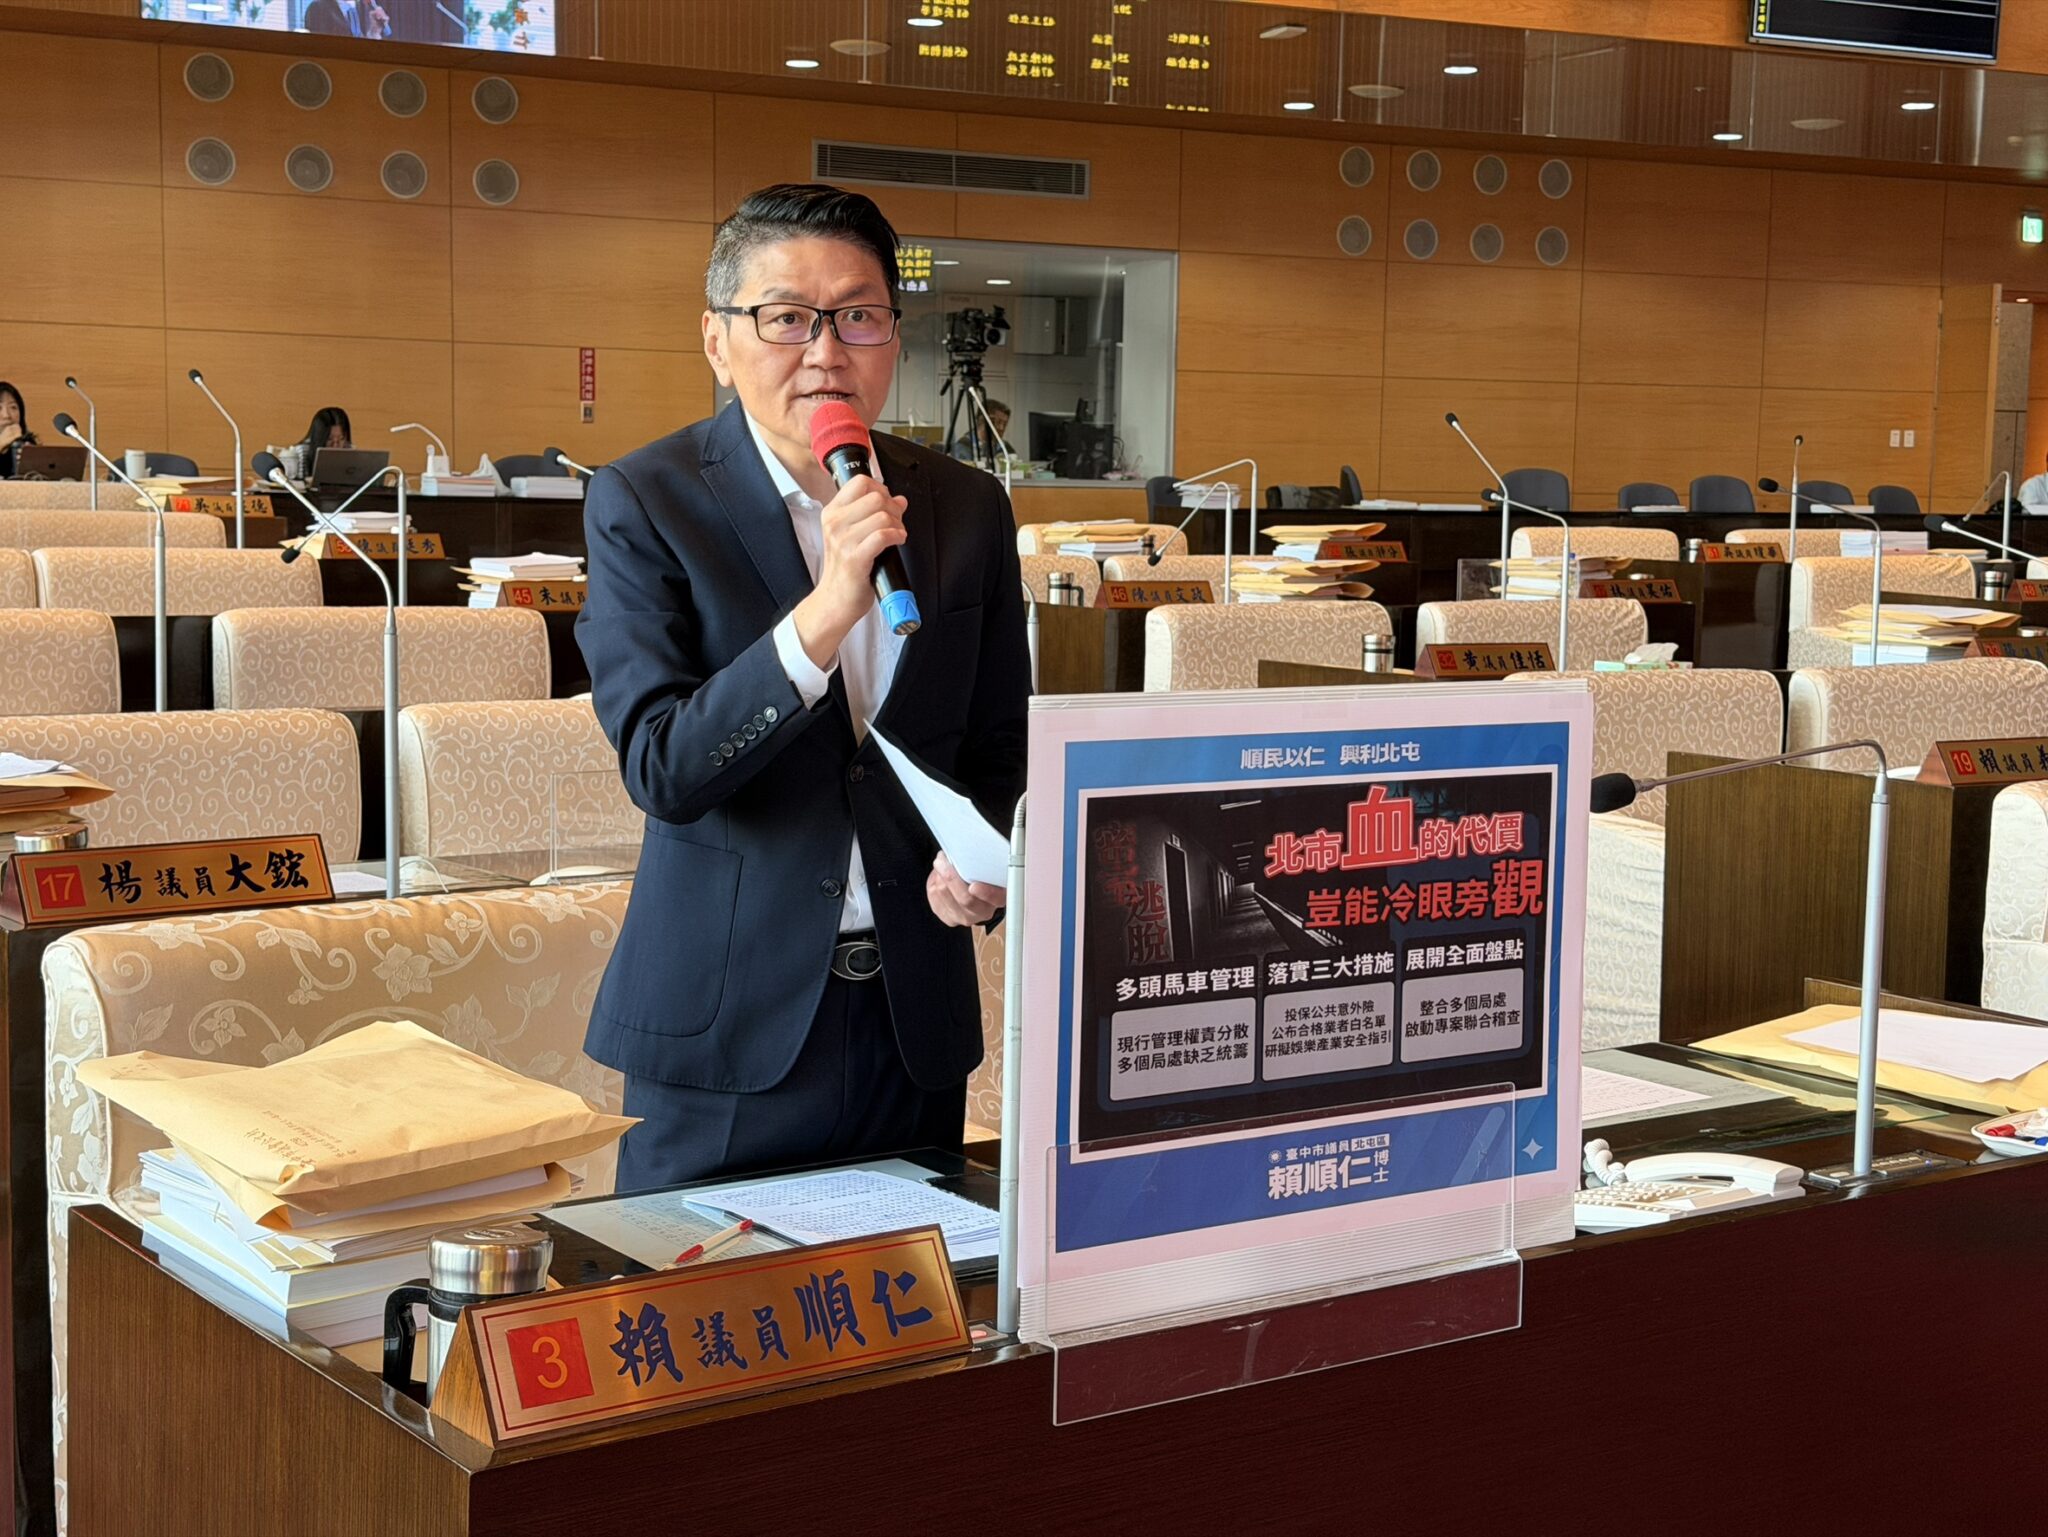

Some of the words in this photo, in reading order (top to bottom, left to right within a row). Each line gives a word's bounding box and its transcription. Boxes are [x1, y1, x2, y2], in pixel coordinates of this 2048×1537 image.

[514, 589, 532, 604] 45
[1112, 587, 1127, 600] 46
[1438, 651, 1456, 668] 32
[1241, 745, 1326, 770] 順民以仁
[1340, 741, 1421, 765] 興利北屯
[1953, 751, 1973, 773] 19
[41, 872, 76, 902] 17
[97, 847, 310, 905] 楊議員大鋐
[1304, 859, 1544, 928] 豈能冷眼旁觀
[1267, 950, 1395, 988] 落實三大措施
[1405, 938, 1525, 972] 展開全面盤點
[1116, 964, 1256, 1002] 多頭馬車管理
[1284, 999, 1375, 1023] 投保公共意外險
[1419, 991, 1508, 1017] 整合多個局處
[1116, 1022, 1250, 1053] 現行管理權責分散
[1271, 1014, 1387, 1040] 公布合格業者白名單
[1264, 1029, 1392, 1058] 研擬娛樂產業安全指引
[1117, 1042, 1249, 1075] 多個局處缺乏統籌
[1353, 1135, 1387, 1150] 北屯區
[1267, 1154, 1373, 1200] 賴順仁
[1372, 1149, 1390, 1184] 博士
[531, 1335, 568, 1390] 3
[608, 1268, 934, 1387] 賴議員順仁
